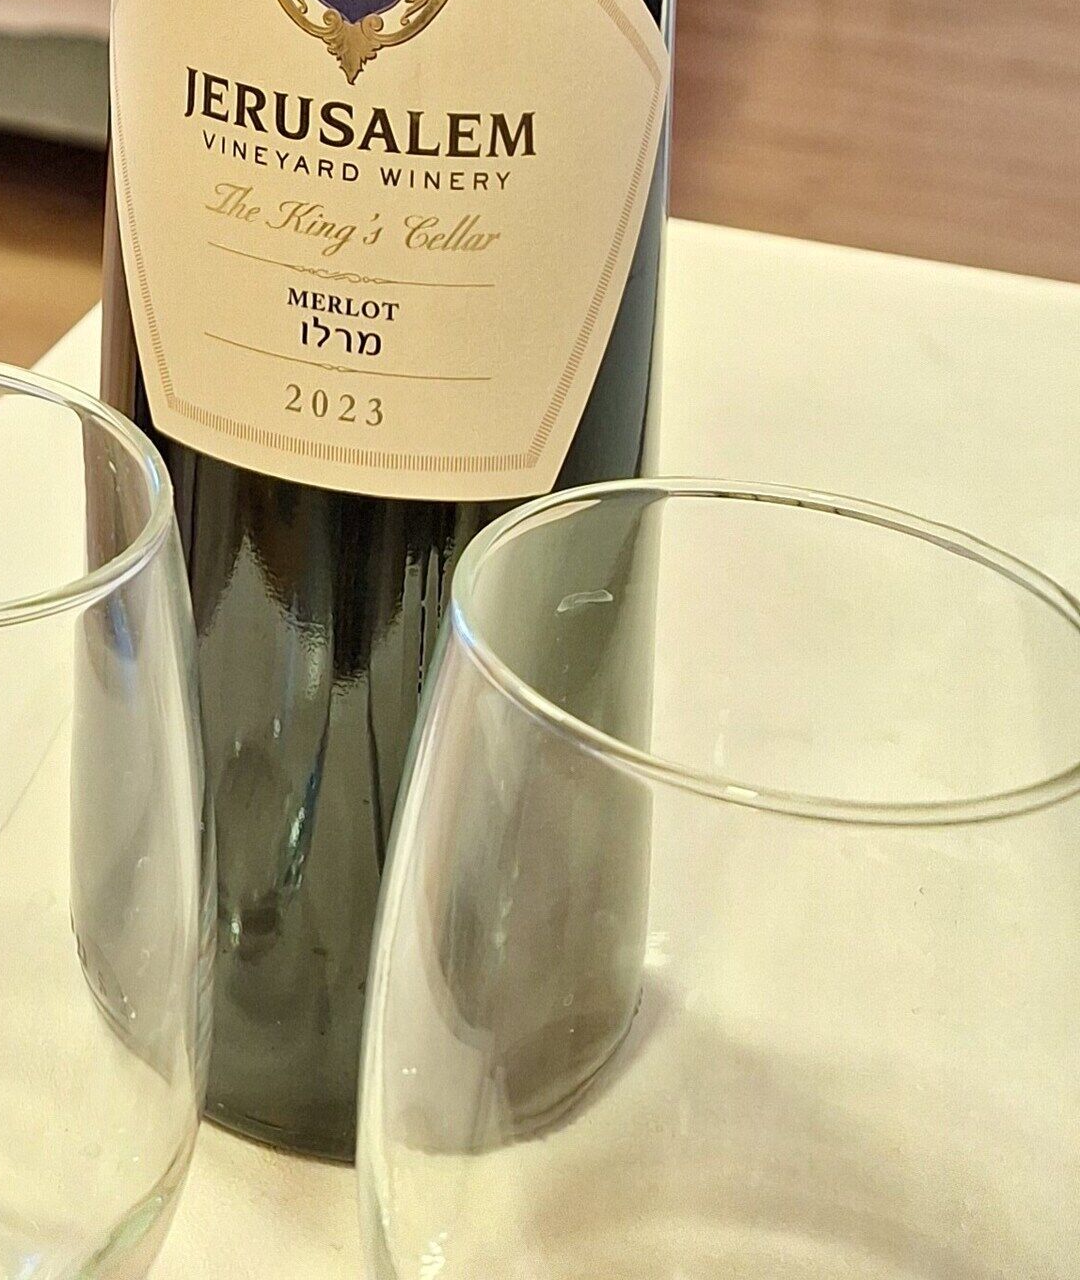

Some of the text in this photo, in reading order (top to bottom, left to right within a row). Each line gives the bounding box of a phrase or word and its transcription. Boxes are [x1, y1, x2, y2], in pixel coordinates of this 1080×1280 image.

[184, 66, 536, 158] JERUSALEM
[202, 129, 511, 190] VINEYARD WINERY
[205, 183, 500, 257] The King's Cellar
[287, 287, 400, 321] MERLOT
[301, 316, 382, 356] מרלו
[284, 383, 384, 426] 2023
